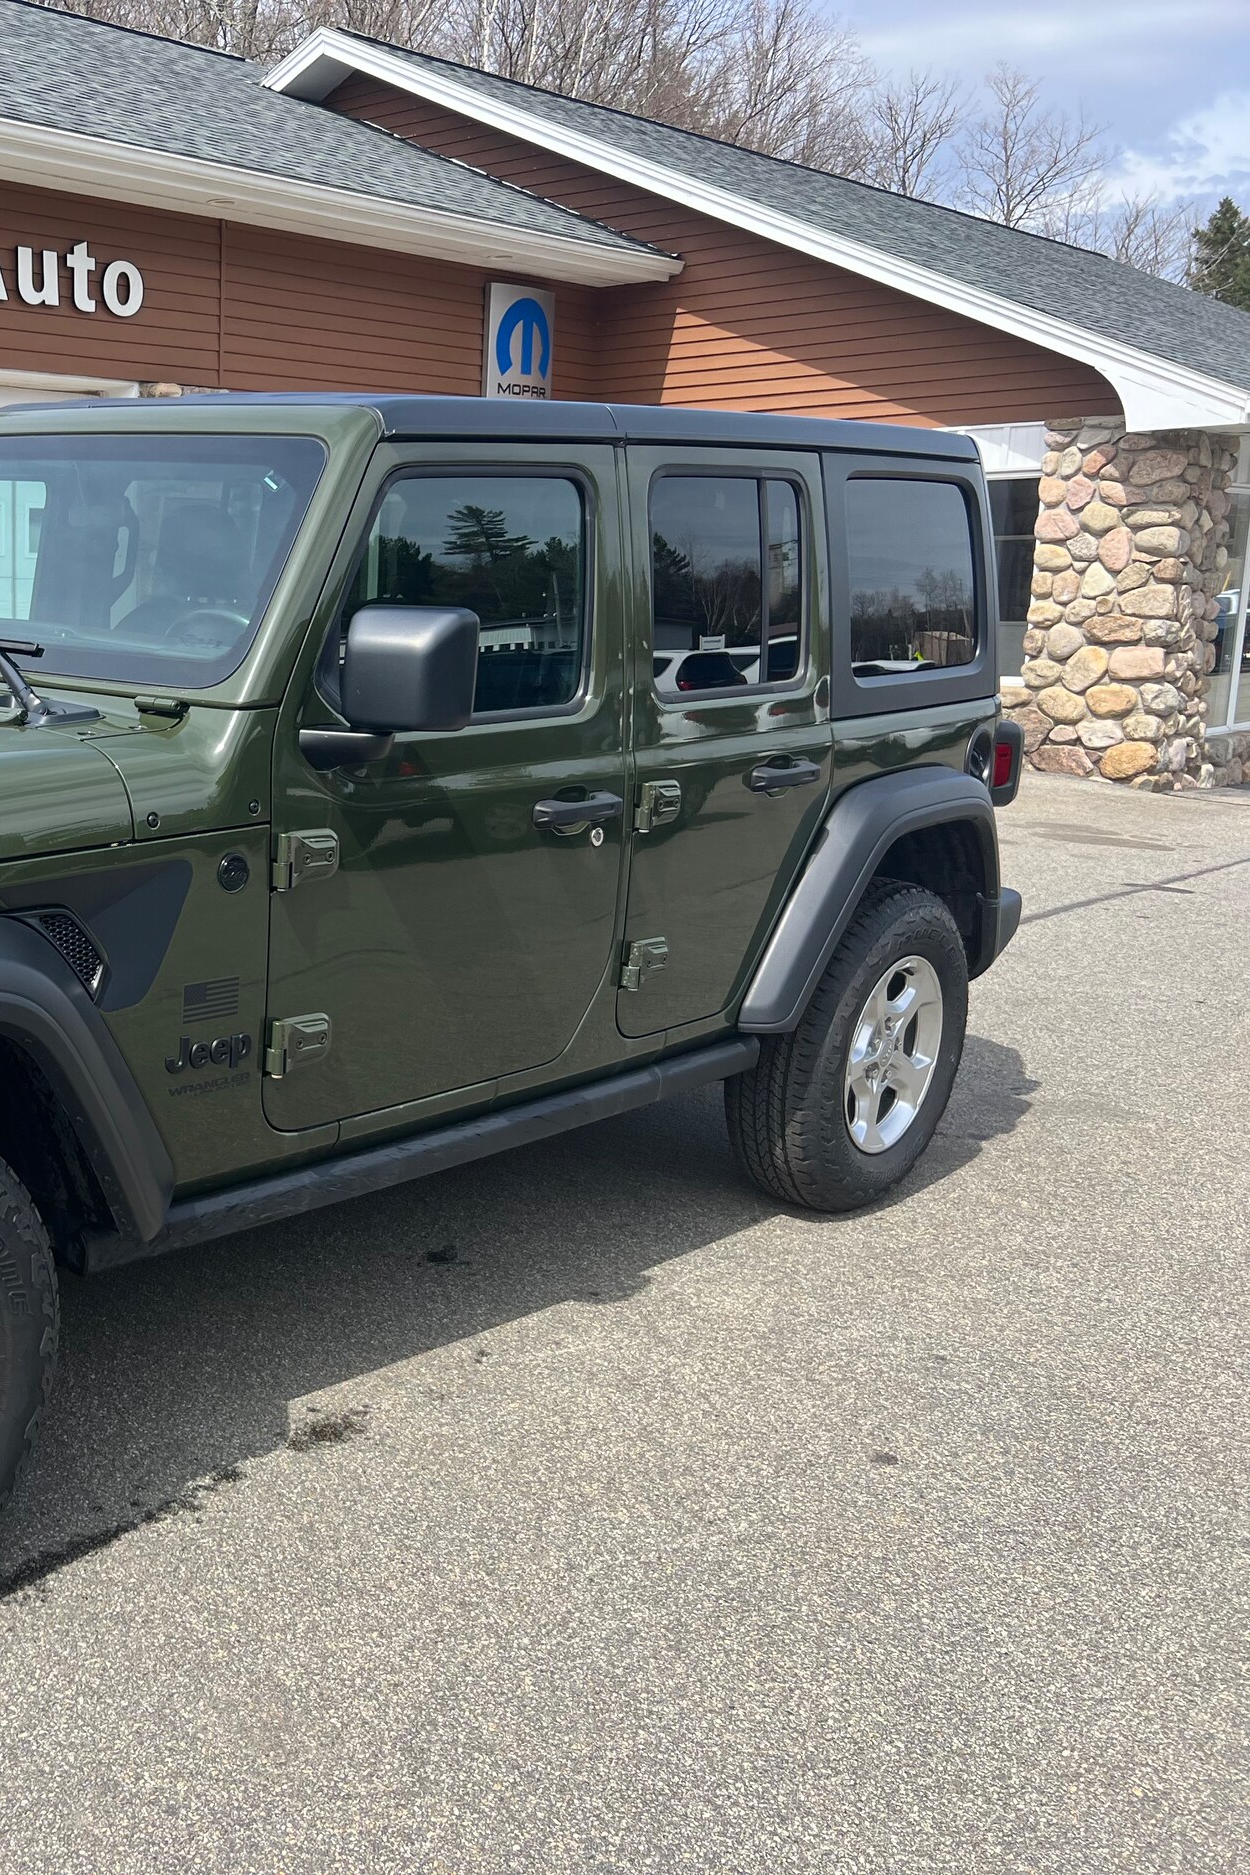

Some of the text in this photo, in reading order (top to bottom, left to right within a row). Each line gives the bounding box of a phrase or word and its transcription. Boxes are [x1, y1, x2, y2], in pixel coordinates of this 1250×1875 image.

[497, 382, 546, 399] MOPAR
[164, 1032, 252, 1074] Jeep
[168, 1072, 250, 1097] WRANGLER
